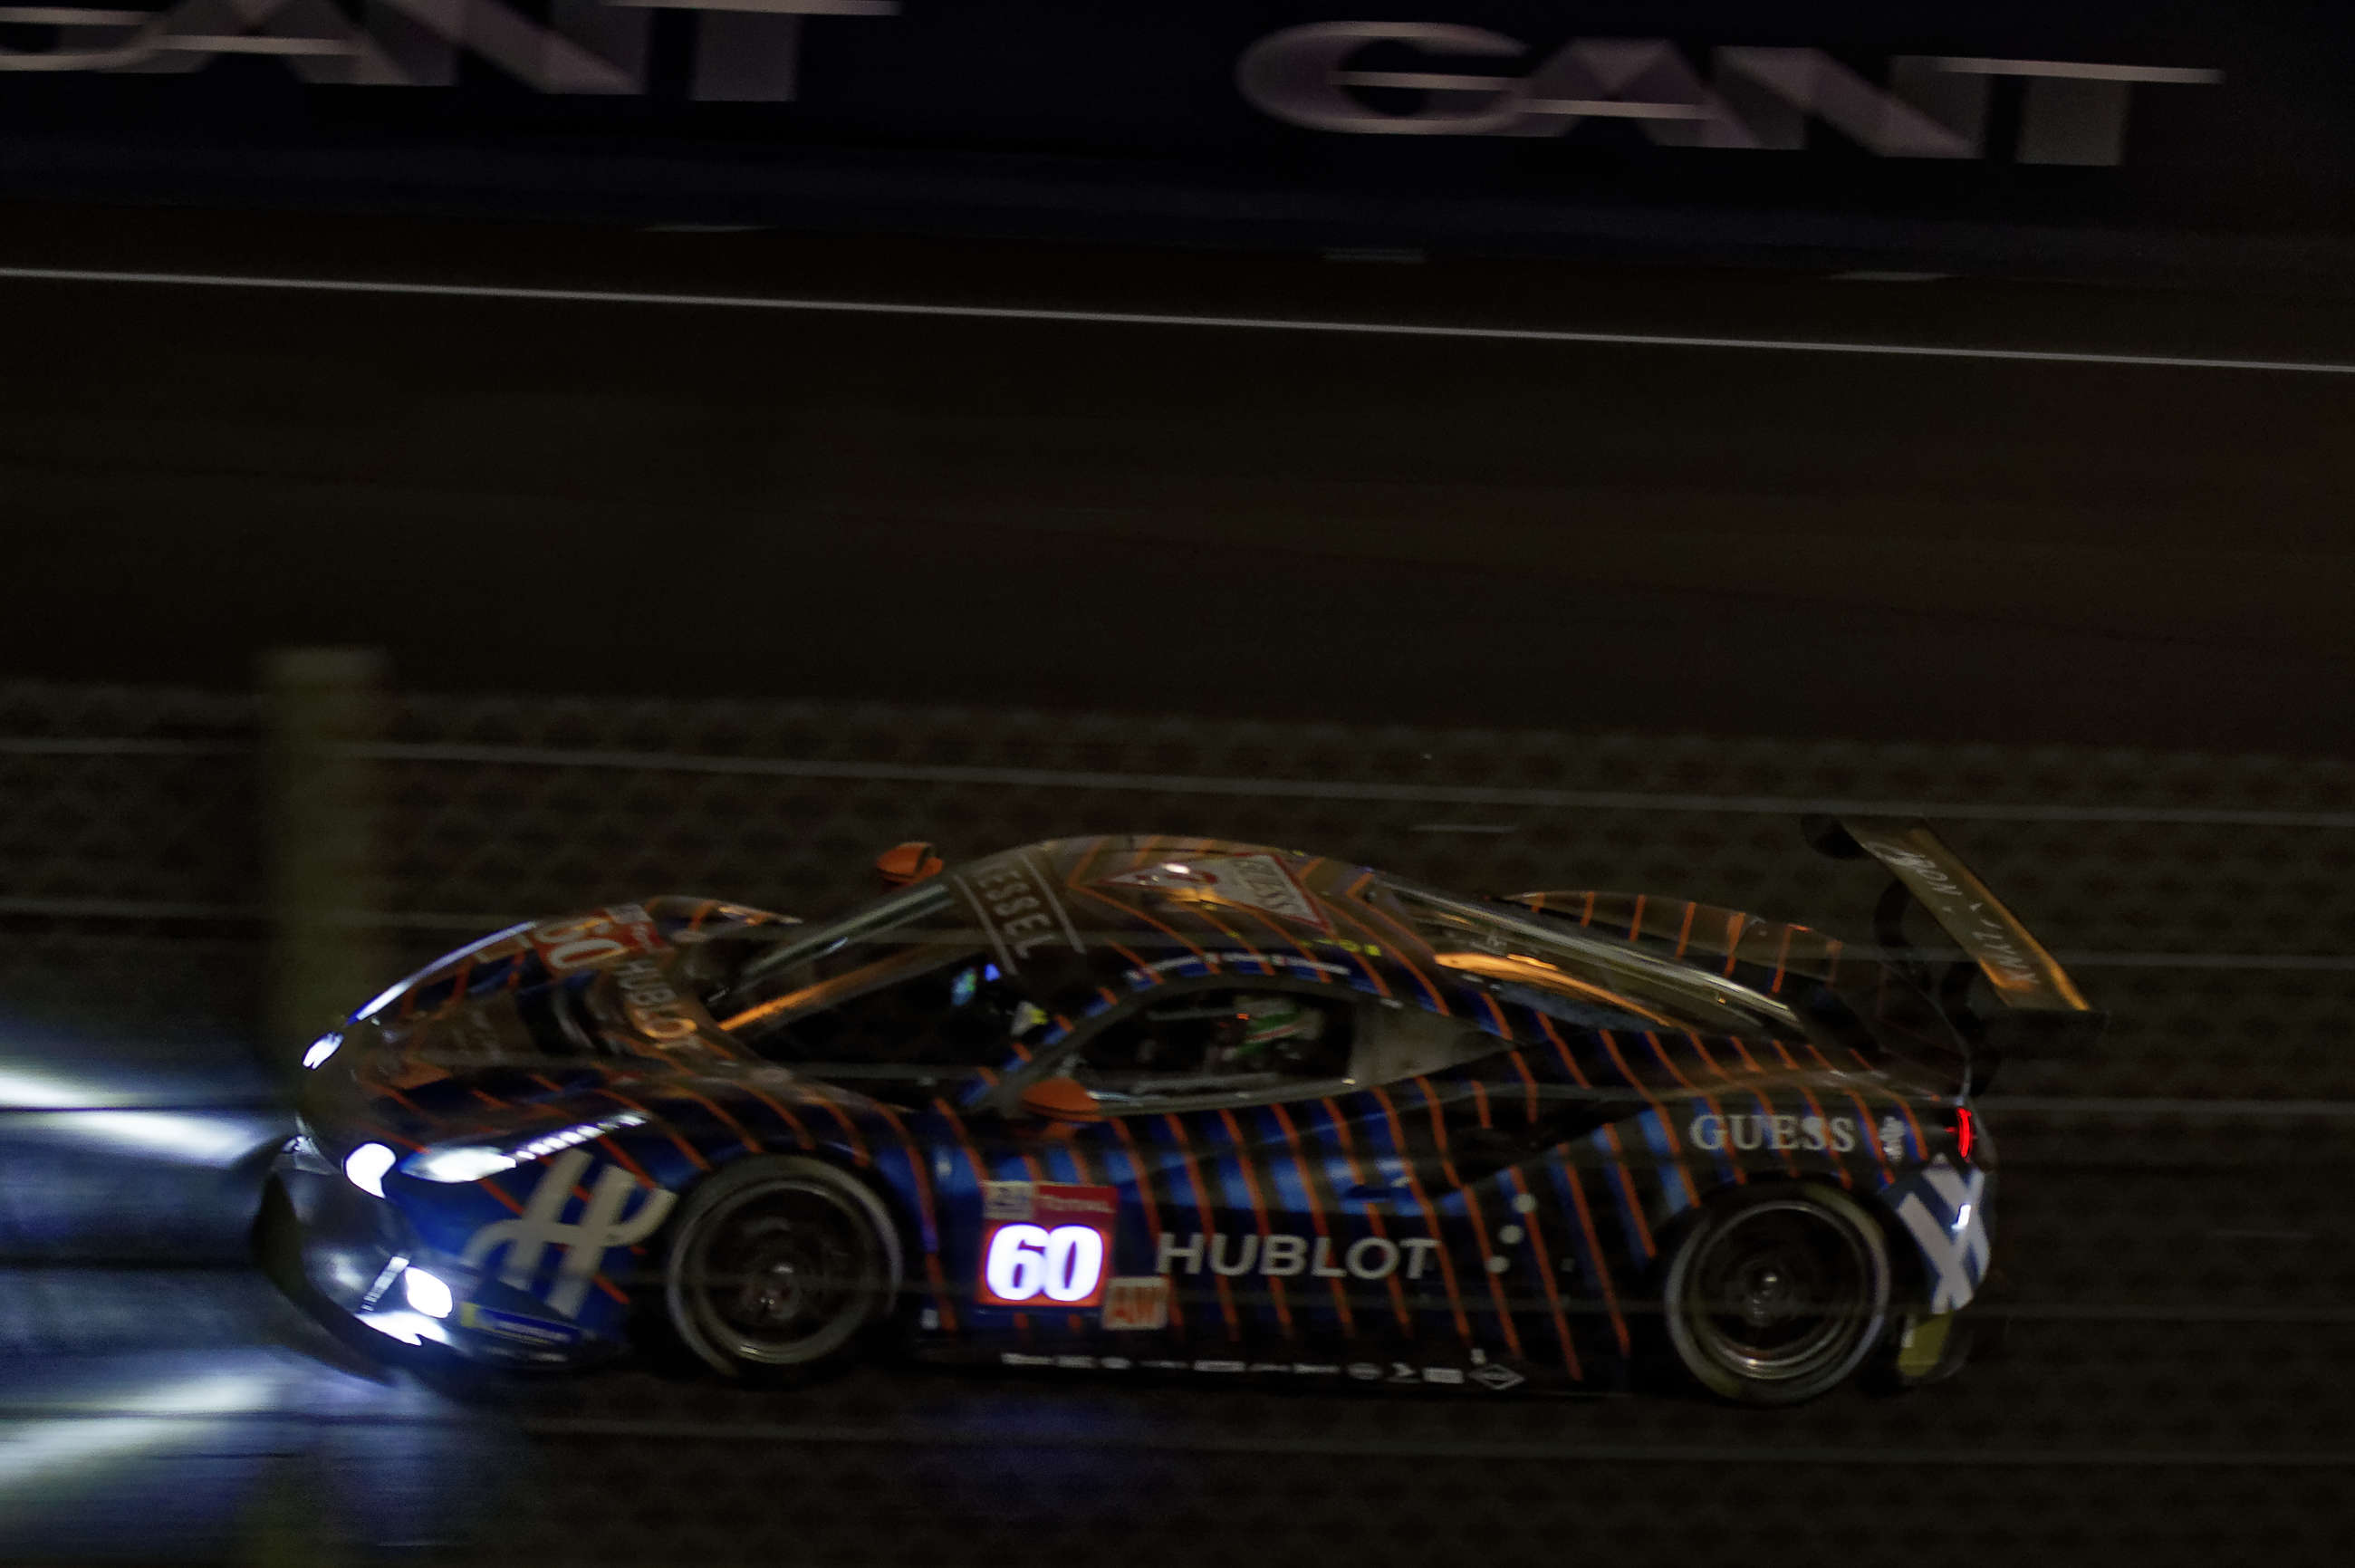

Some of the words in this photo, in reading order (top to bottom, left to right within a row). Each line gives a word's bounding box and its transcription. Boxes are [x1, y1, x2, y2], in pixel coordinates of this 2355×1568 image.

[1233, 20, 2225, 166] GANT
[1687, 1113, 1855, 1153] GUESS
[985, 1222, 1104, 1303] 60
[1156, 1231, 1442, 1281] HUBLOT
